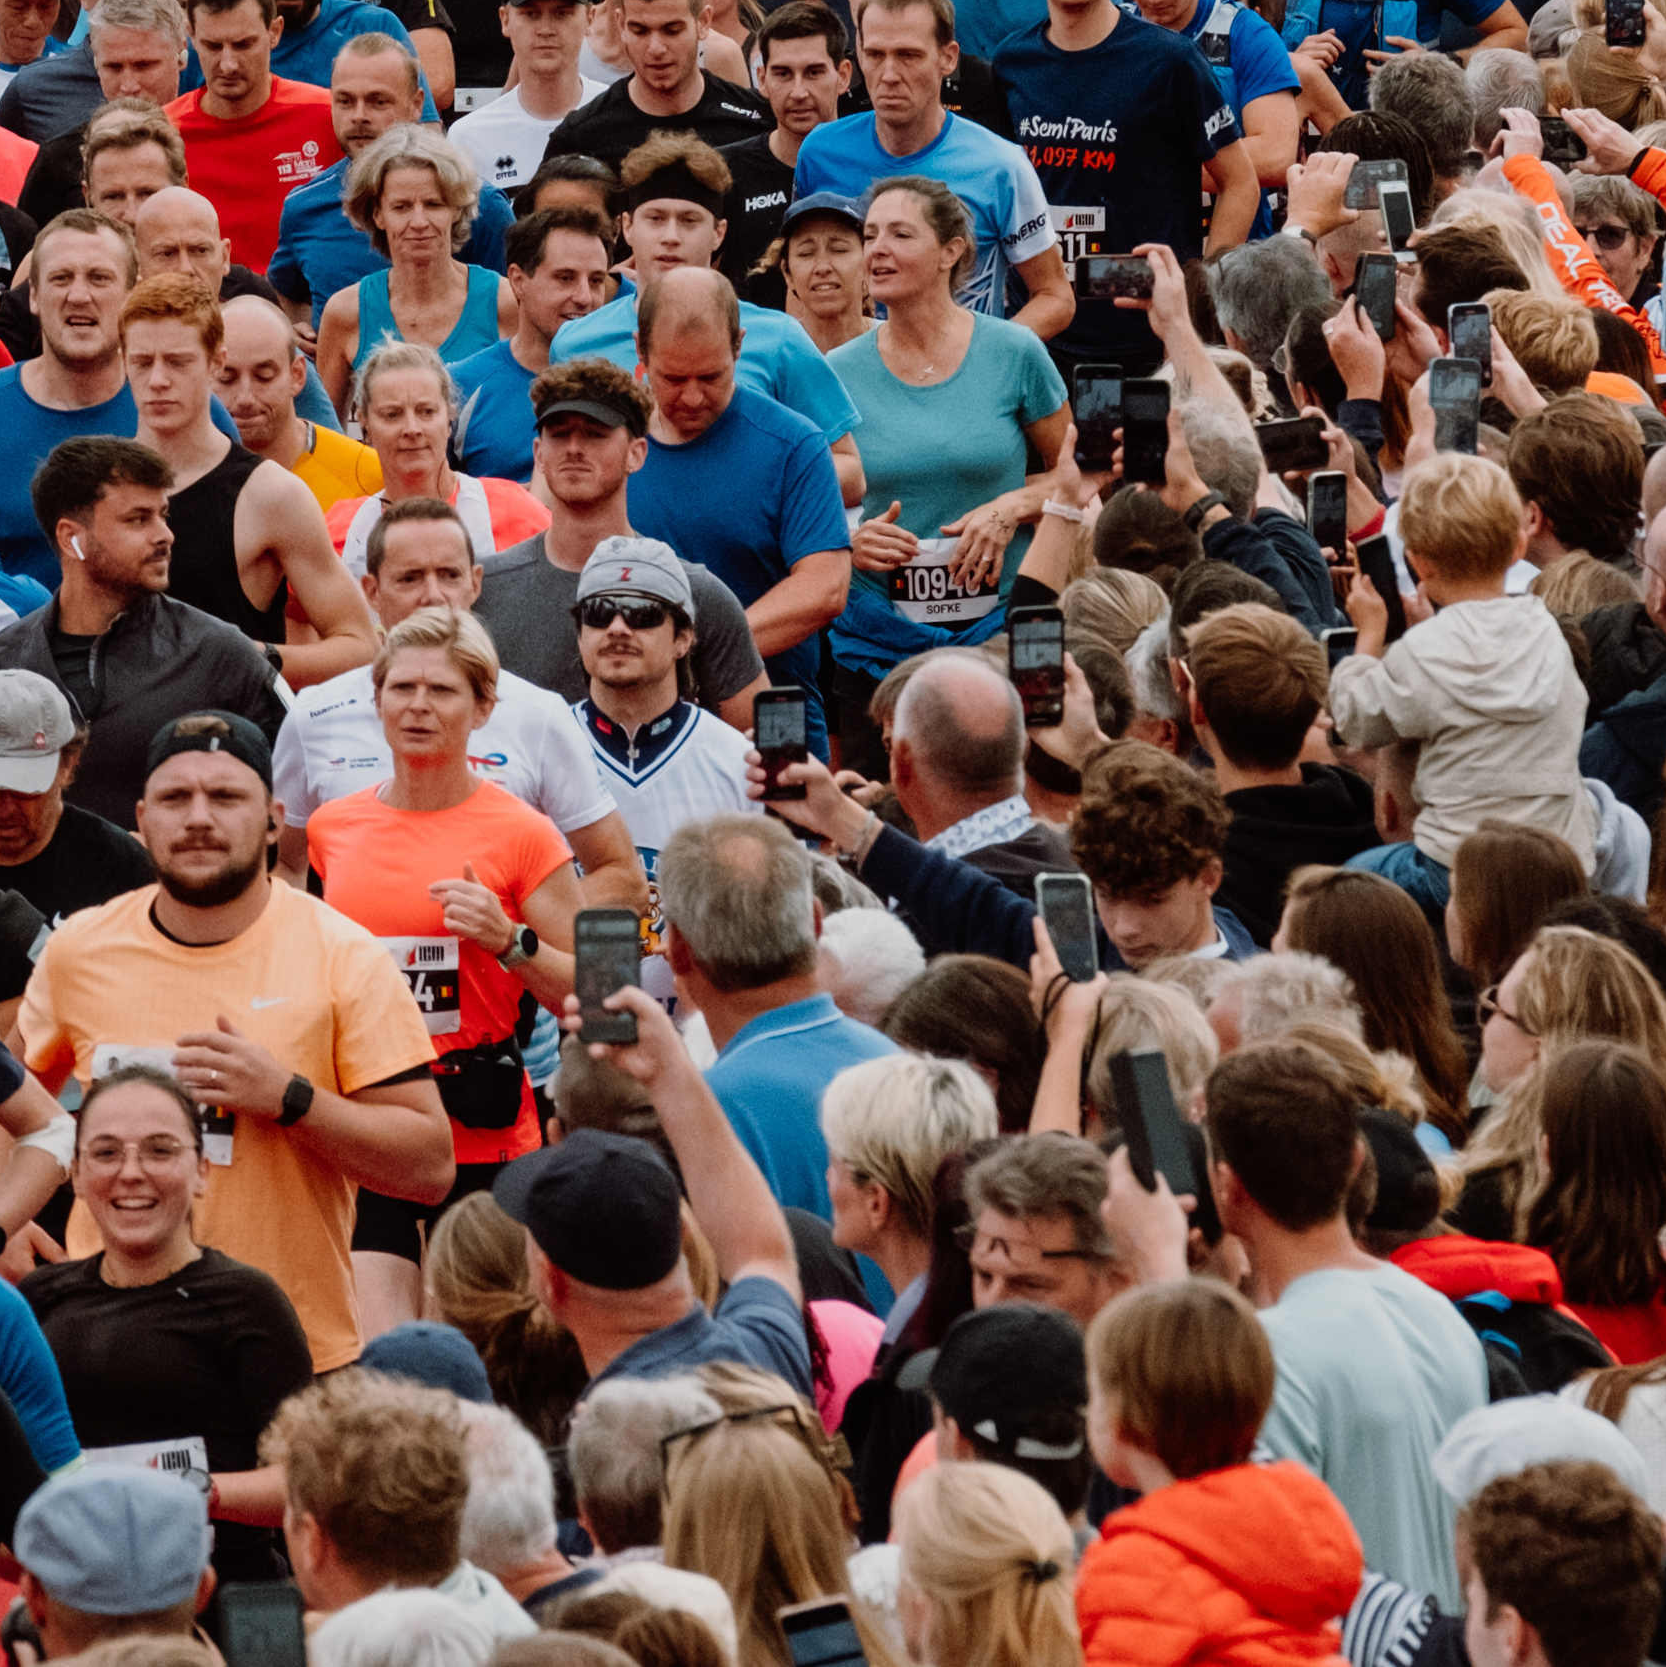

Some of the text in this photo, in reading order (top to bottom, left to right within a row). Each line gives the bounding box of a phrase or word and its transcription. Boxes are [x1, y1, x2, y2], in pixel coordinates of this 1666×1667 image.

[721, 101, 753, 117] CRAFT
[1082, 148, 1117, 174] KM
[745, 190, 788, 213] HOKA
[926, 603, 962, 614] SOFKE
